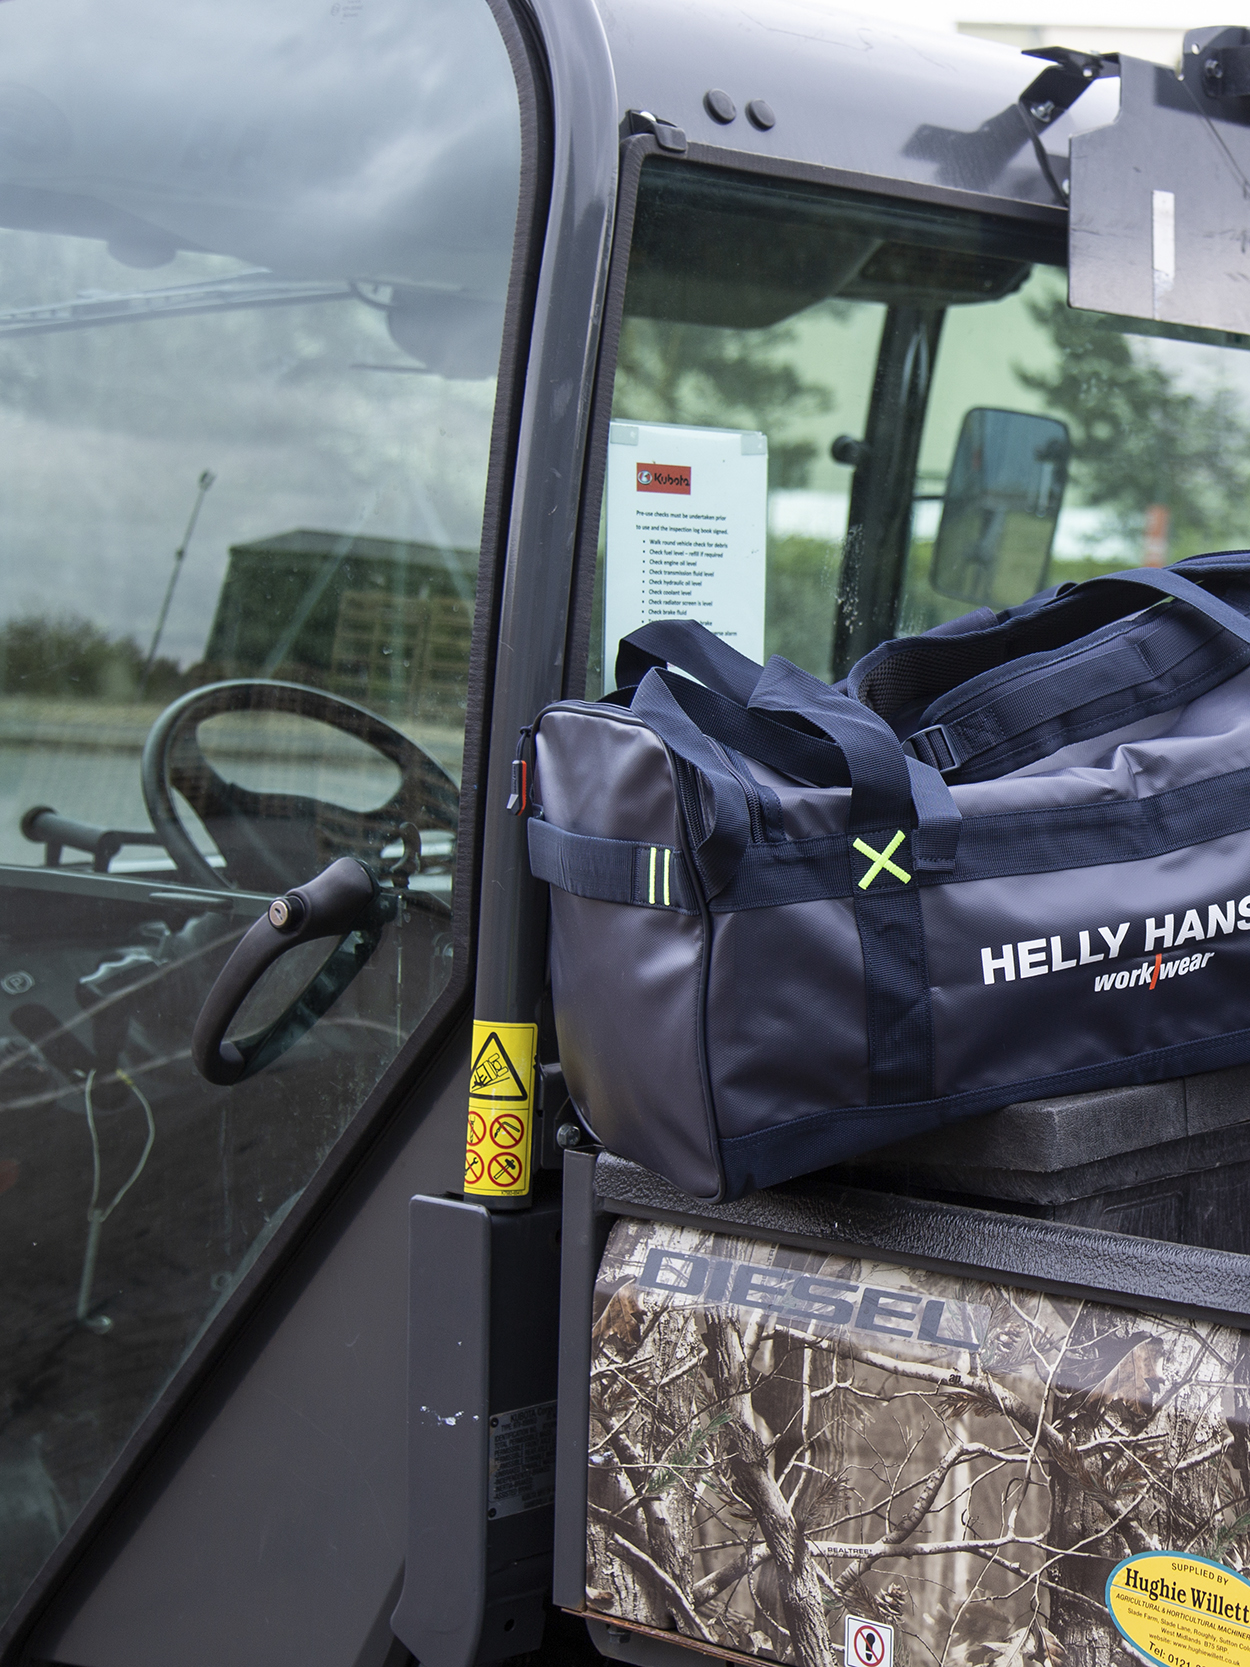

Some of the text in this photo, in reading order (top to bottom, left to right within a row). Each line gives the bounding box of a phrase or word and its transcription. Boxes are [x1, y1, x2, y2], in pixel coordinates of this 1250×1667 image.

[654, 472, 690, 487] Kubota
[980, 922, 1131, 985] HELLY
[638, 1247, 981, 1351] DIESEL
[827, 1546, 870, 1554] REALTREE
[1171, 1562, 1230, 1586] SUPPLIED BY
[1124, 1567, 1187, 1604] Hughie
[1190, 1588, 1250, 1624] Willett
[1115, 1593, 1160, 1613] AGRICULTURAL
[1166, 1608, 1217, 1630] HORTICULTURAL
[1127, 1608, 1143, 1618] Slade
[1160, 1618, 1176, 1629] Slade
[1219, 1636, 1238, 1648] Sutton
[1160, 1627, 1176, 1636] West
[1176, 1632, 1202, 1646] Midlands
[1204, 1640, 1216, 1650] B75
[1148, 1641, 1166, 1659] Tel:
